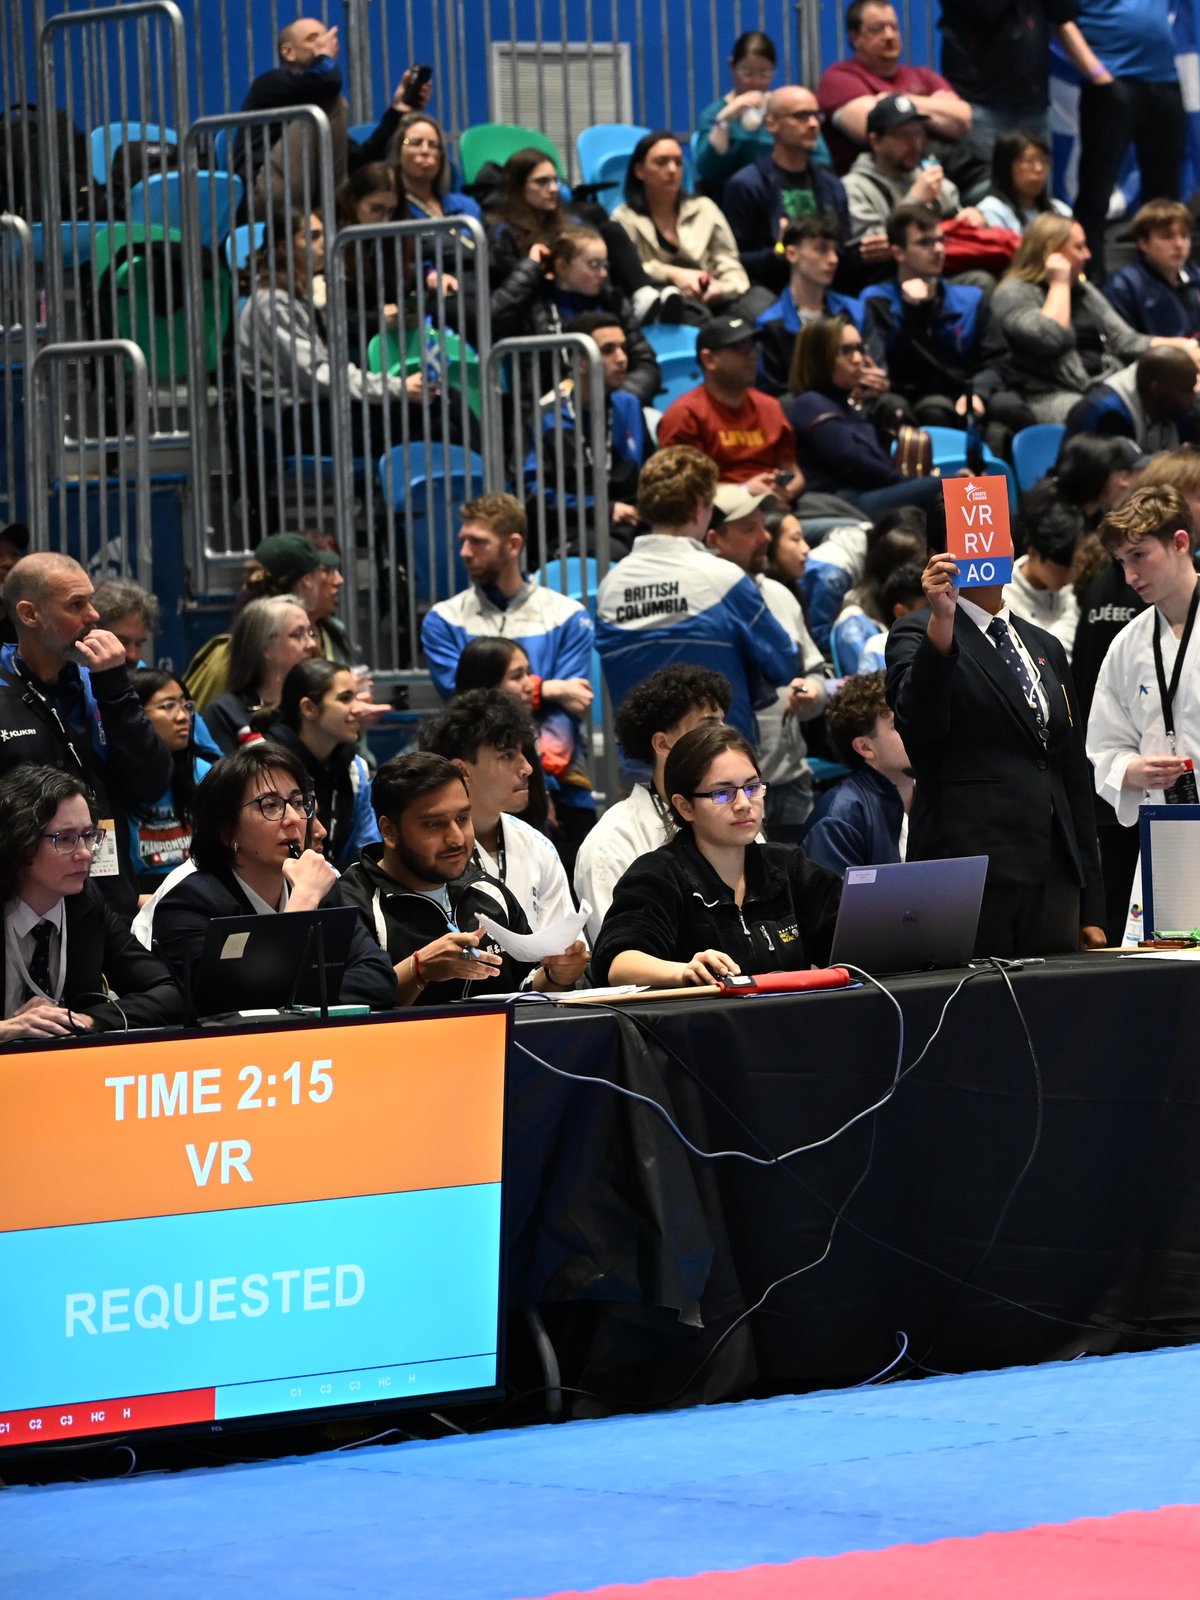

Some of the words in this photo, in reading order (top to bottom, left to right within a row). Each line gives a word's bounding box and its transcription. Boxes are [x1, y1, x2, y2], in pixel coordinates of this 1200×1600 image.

[961, 504, 993, 527] VR
[964, 531, 994, 554] RV
[966, 562, 995, 583] AO
[624, 581, 679, 602] BRITISH
[616, 597, 688, 623] COLUMBIA
[9, 728, 36, 738] KUKRI
[105, 1068, 221, 1121] TIME
[237, 1059, 333, 1110] 2:15
[185, 1139, 253, 1187] VR
[65, 1264, 365, 1338] REQUESTED
[290, 1388, 302, 1398] C1
[378, 1377, 391, 1388] HC
[409, 1374, 416, 1384] H
[0, 1423, 10, 1433] C1
[29, 1419, 42, 1430] C2
[60, 1415, 73, 1426] C3
[91, 1411, 105, 1422] HC
[123, 1408, 131, 1418] H
